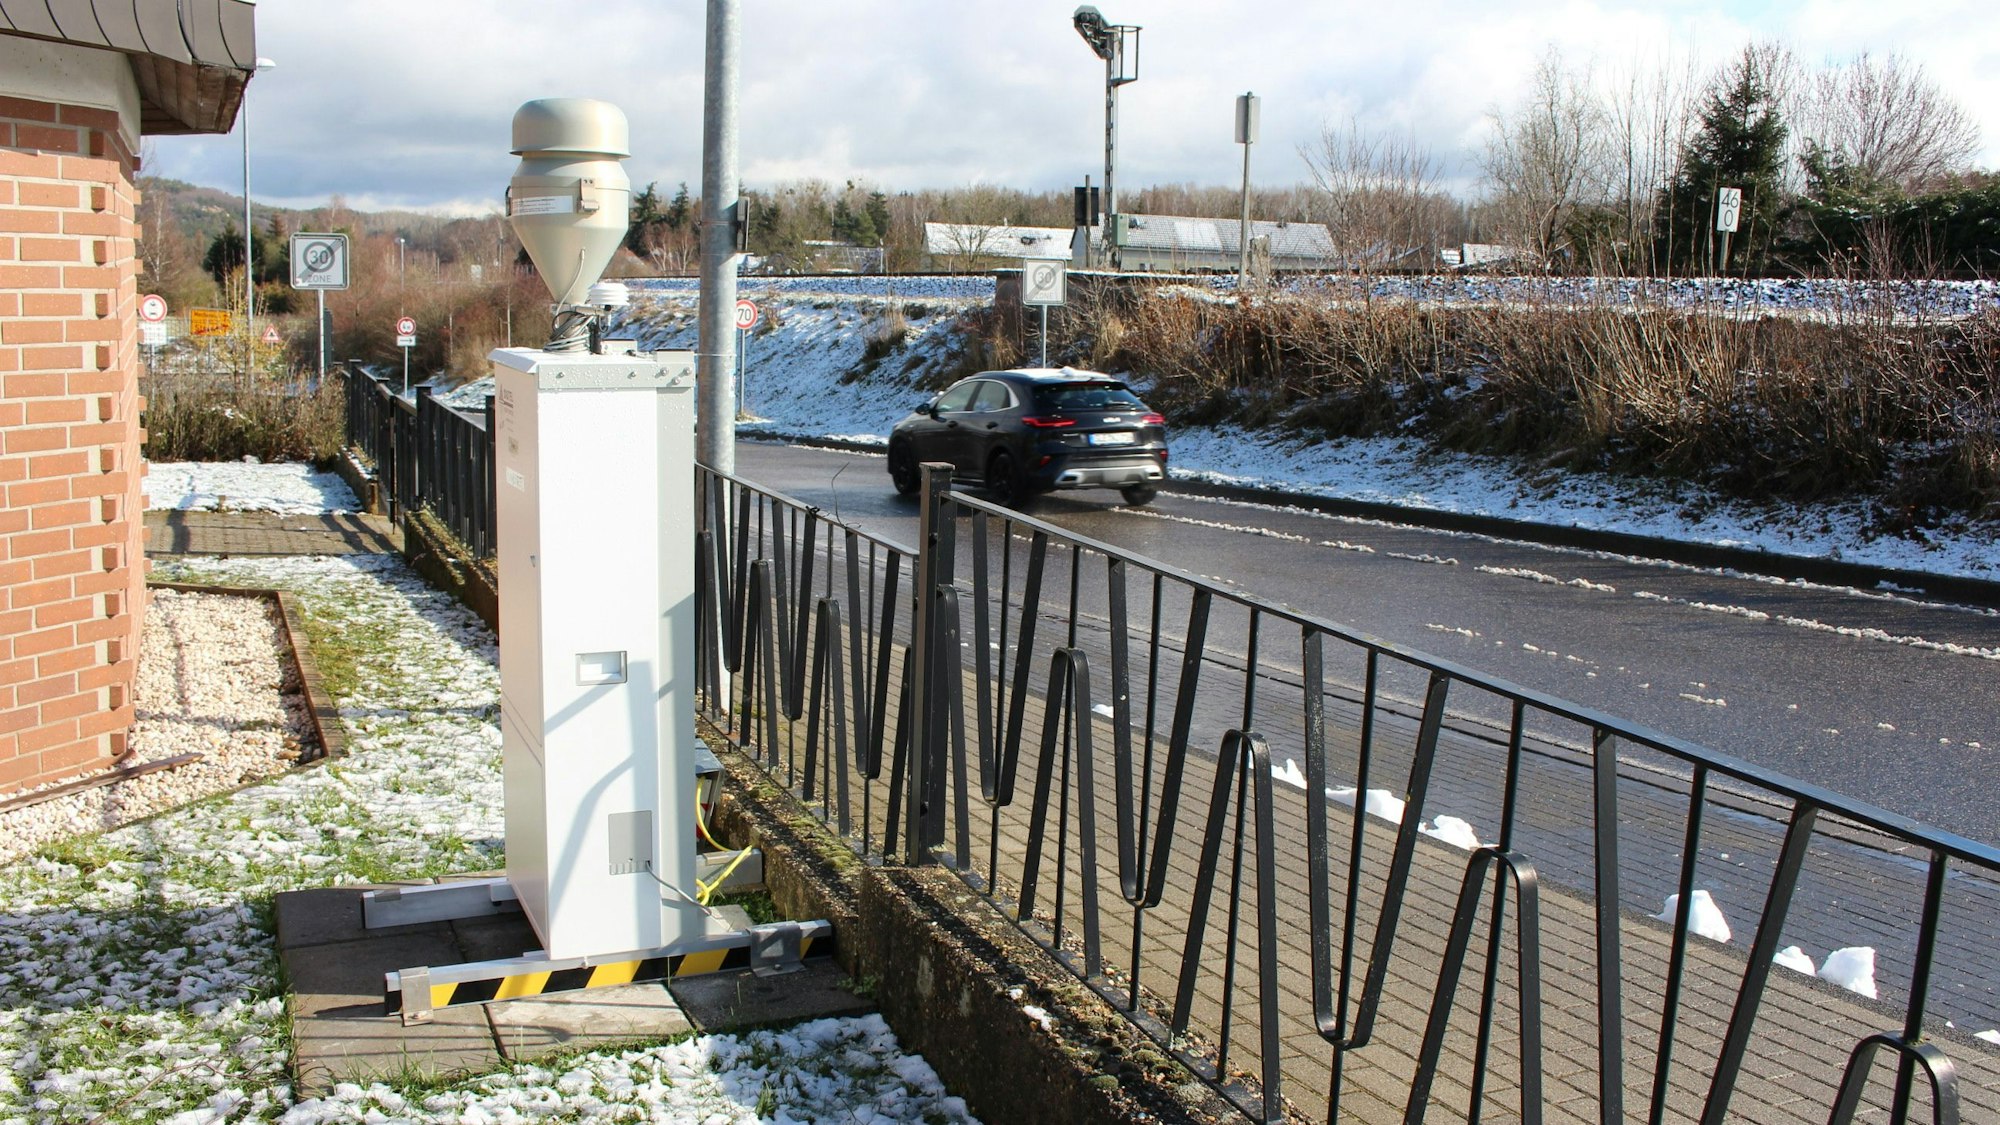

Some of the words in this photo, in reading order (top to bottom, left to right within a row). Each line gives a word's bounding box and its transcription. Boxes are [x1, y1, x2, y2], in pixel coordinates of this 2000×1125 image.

[1721, 189, 1739, 208] 46
[1724, 209, 1733, 227] 0
[309, 250, 328, 264] 30
[307, 274, 332, 283] ZONE
[1037, 271, 1052, 284] 30
[737, 308, 752, 321] 70
